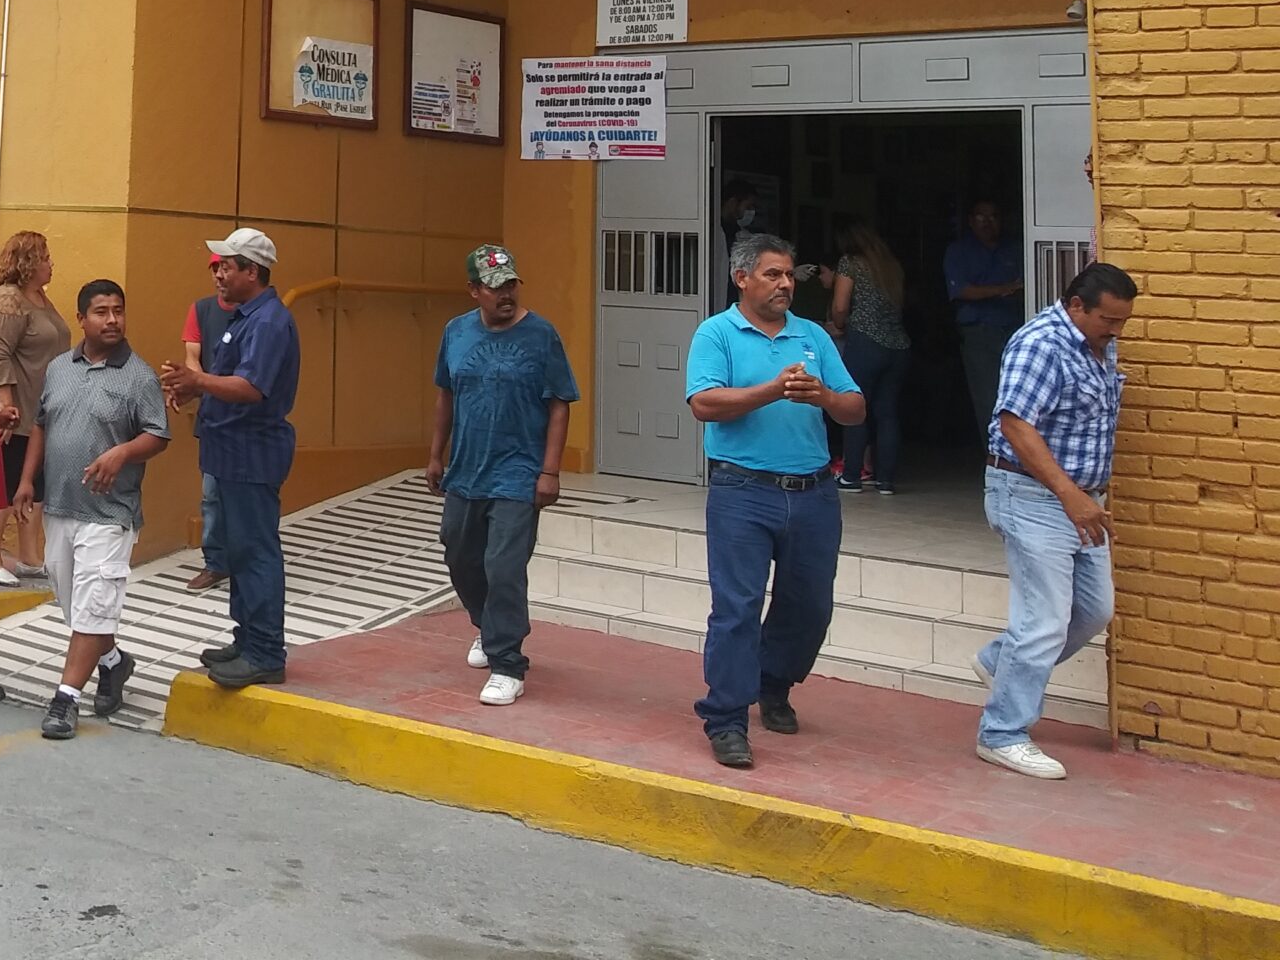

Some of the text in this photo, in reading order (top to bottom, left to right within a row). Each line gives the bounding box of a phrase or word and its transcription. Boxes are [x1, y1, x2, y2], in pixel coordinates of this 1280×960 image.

[610, 7, 617, 15] DE
[648, 4, 664, 12] 12:00
[637, 14, 645, 22] PM
[626, 24, 657, 34] SABADOS
[609, 36, 617, 44] DE
[526, 71, 663, 82] Solo se permitirá la entrada al
[540, 85, 586, 95] agremiado
[588, 85, 605, 94] que
[608, 85, 637, 94] venga
[536, 98, 568, 107] realizar
[570, 98, 580, 106] un
[582, 96, 615, 105] trámite
[626, 97, 651, 106] pago
[544, 110, 584, 118] Detengamos
[592, 110, 640, 118] propagación
[588, 130, 595, 141] A
[598, 130, 657, 141] CUIDARTE!
